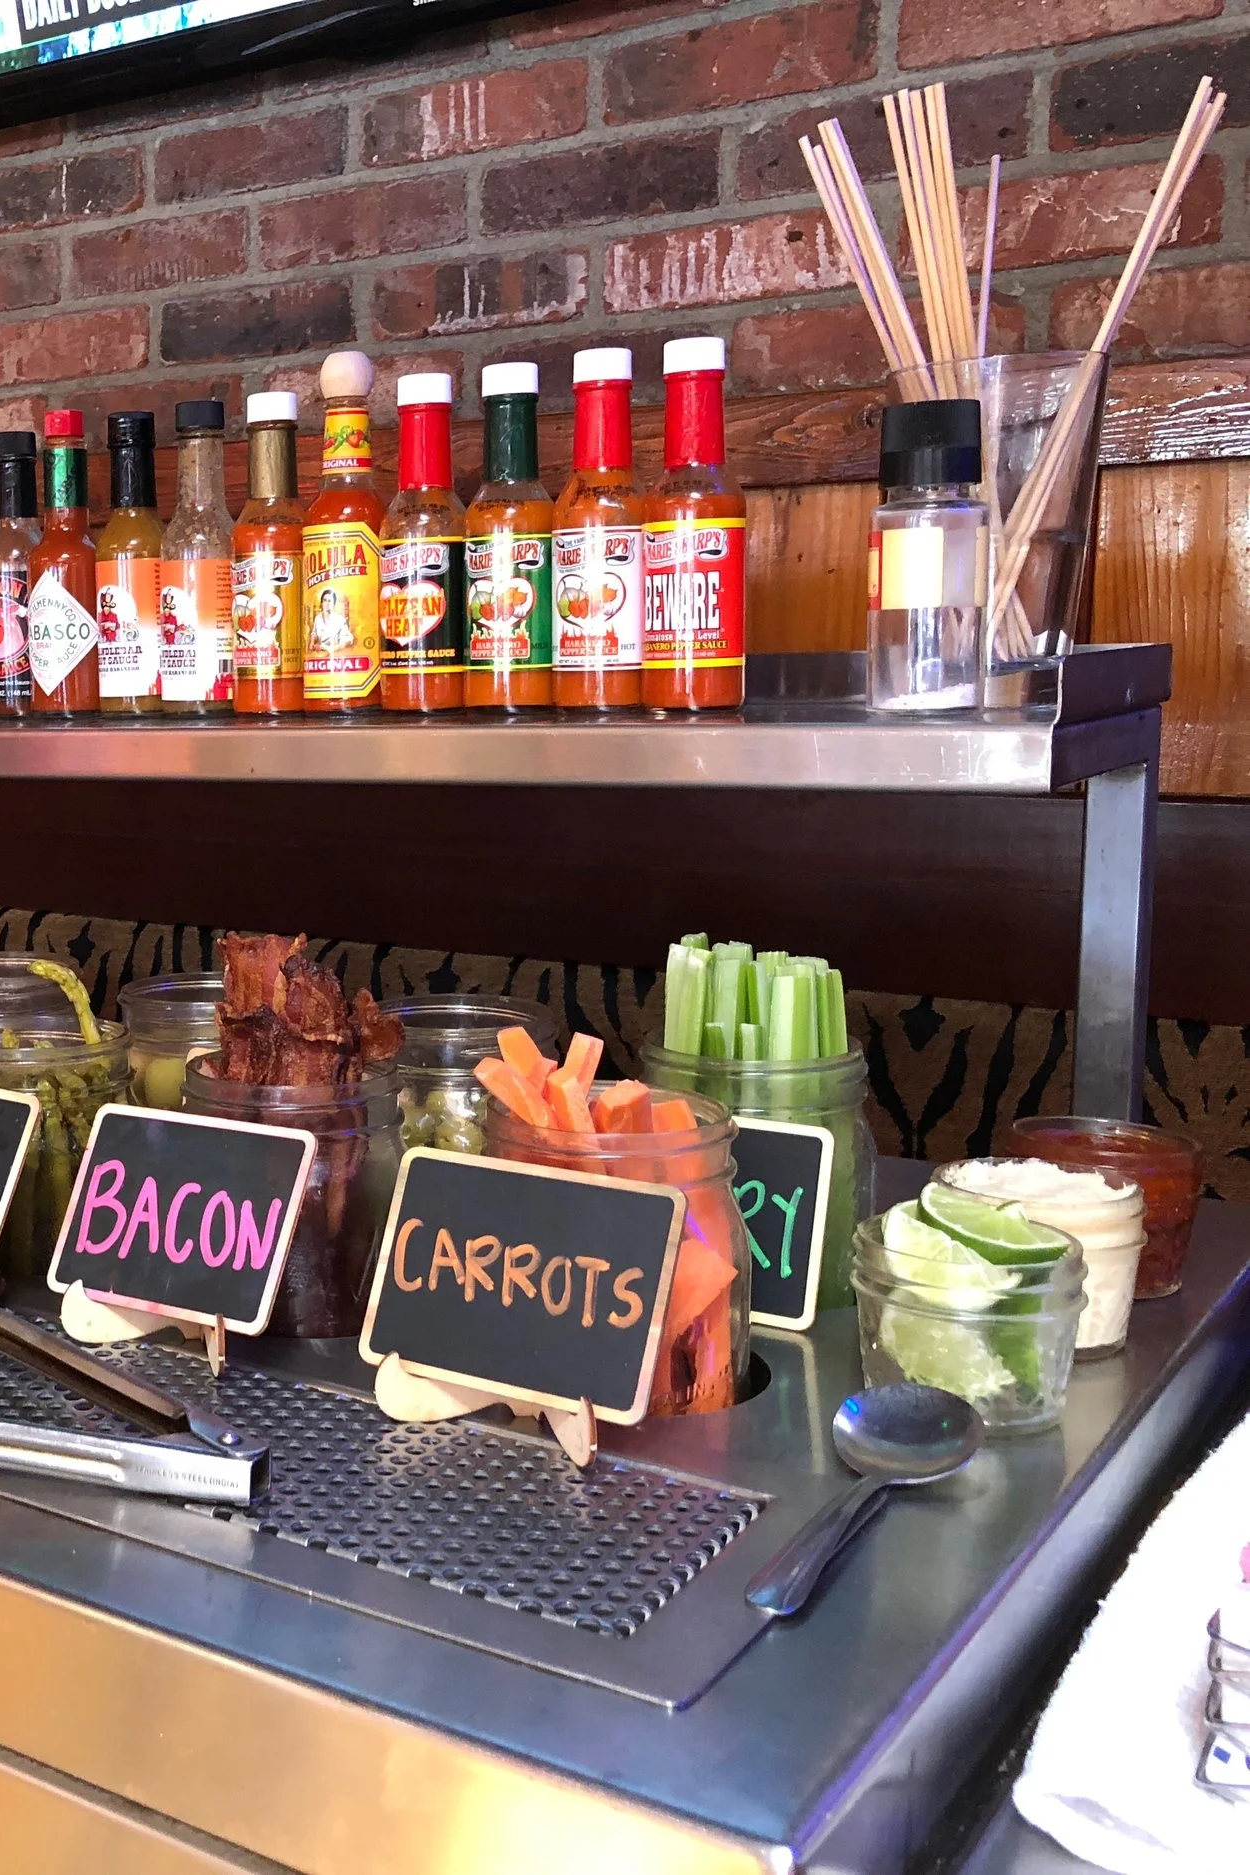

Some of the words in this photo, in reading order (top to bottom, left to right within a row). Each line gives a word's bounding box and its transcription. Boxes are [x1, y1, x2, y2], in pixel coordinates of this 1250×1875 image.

[508, 542, 539, 563] ARP'S
[675, 530, 722, 558] SARP'S
[231, 569, 247, 586] ARIE
[248, 560, 288, 583] SP'S
[381, 560, 398, 574] ARIE
[308, 573, 326, 587] HOT
[328, 566, 360, 579] SAUCE
[380, 597, 442, 617] ELIZEAN
[644, 571, 720, 632] BEWARE
[30, 623, 91, 640] BASCO
[386, 618, 423, 637] HEAT
[646, 633, 674, 641] omatose
[698, 630, 720, 640] Level
[58, 642, 78, 664] AUCE
[98, 645, 142, 656] NDLEBAR
[564, 640, 611, 648] HABANEO
[588, 647, 618, 655] SCE
[646, 642, 670, 651] ANERO
[671, 640, 701, 650] PEPER
[702, 640, 727, 649] SAUCE
[108, 656, 138, 665] SAUCE
[167, 659, 195, 668] SAUCE
[75, 1159, 283, 1271] BACON
[394, 1218, 645, 1328] CARROTS
[181, 1473, 208, 1484] STEEL
